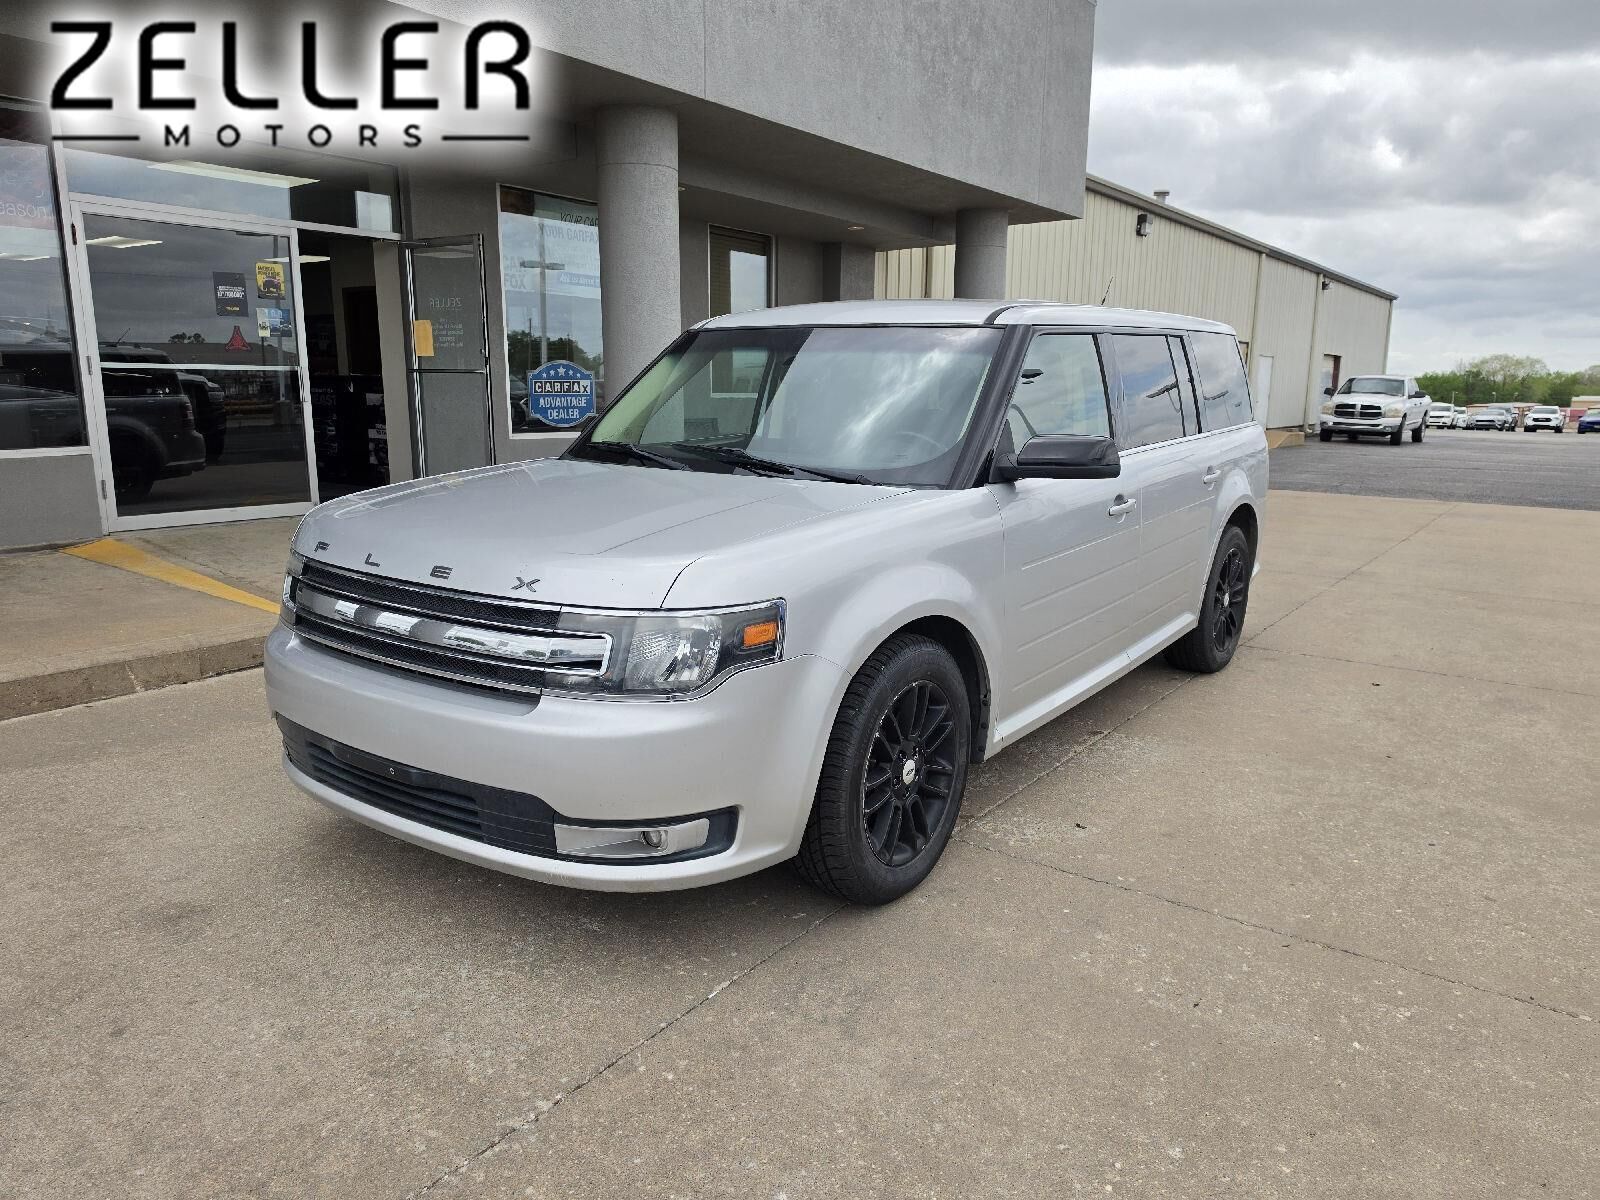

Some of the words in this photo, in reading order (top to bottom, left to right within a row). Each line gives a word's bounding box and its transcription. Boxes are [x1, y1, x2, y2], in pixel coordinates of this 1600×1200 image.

[534, 382, 589, 394] CARFAX
[539, 396, 588, 408] ADVANTAGE
[547, 408, 580, 420] DEALER
[313, 541, 541, 593] FLEX
